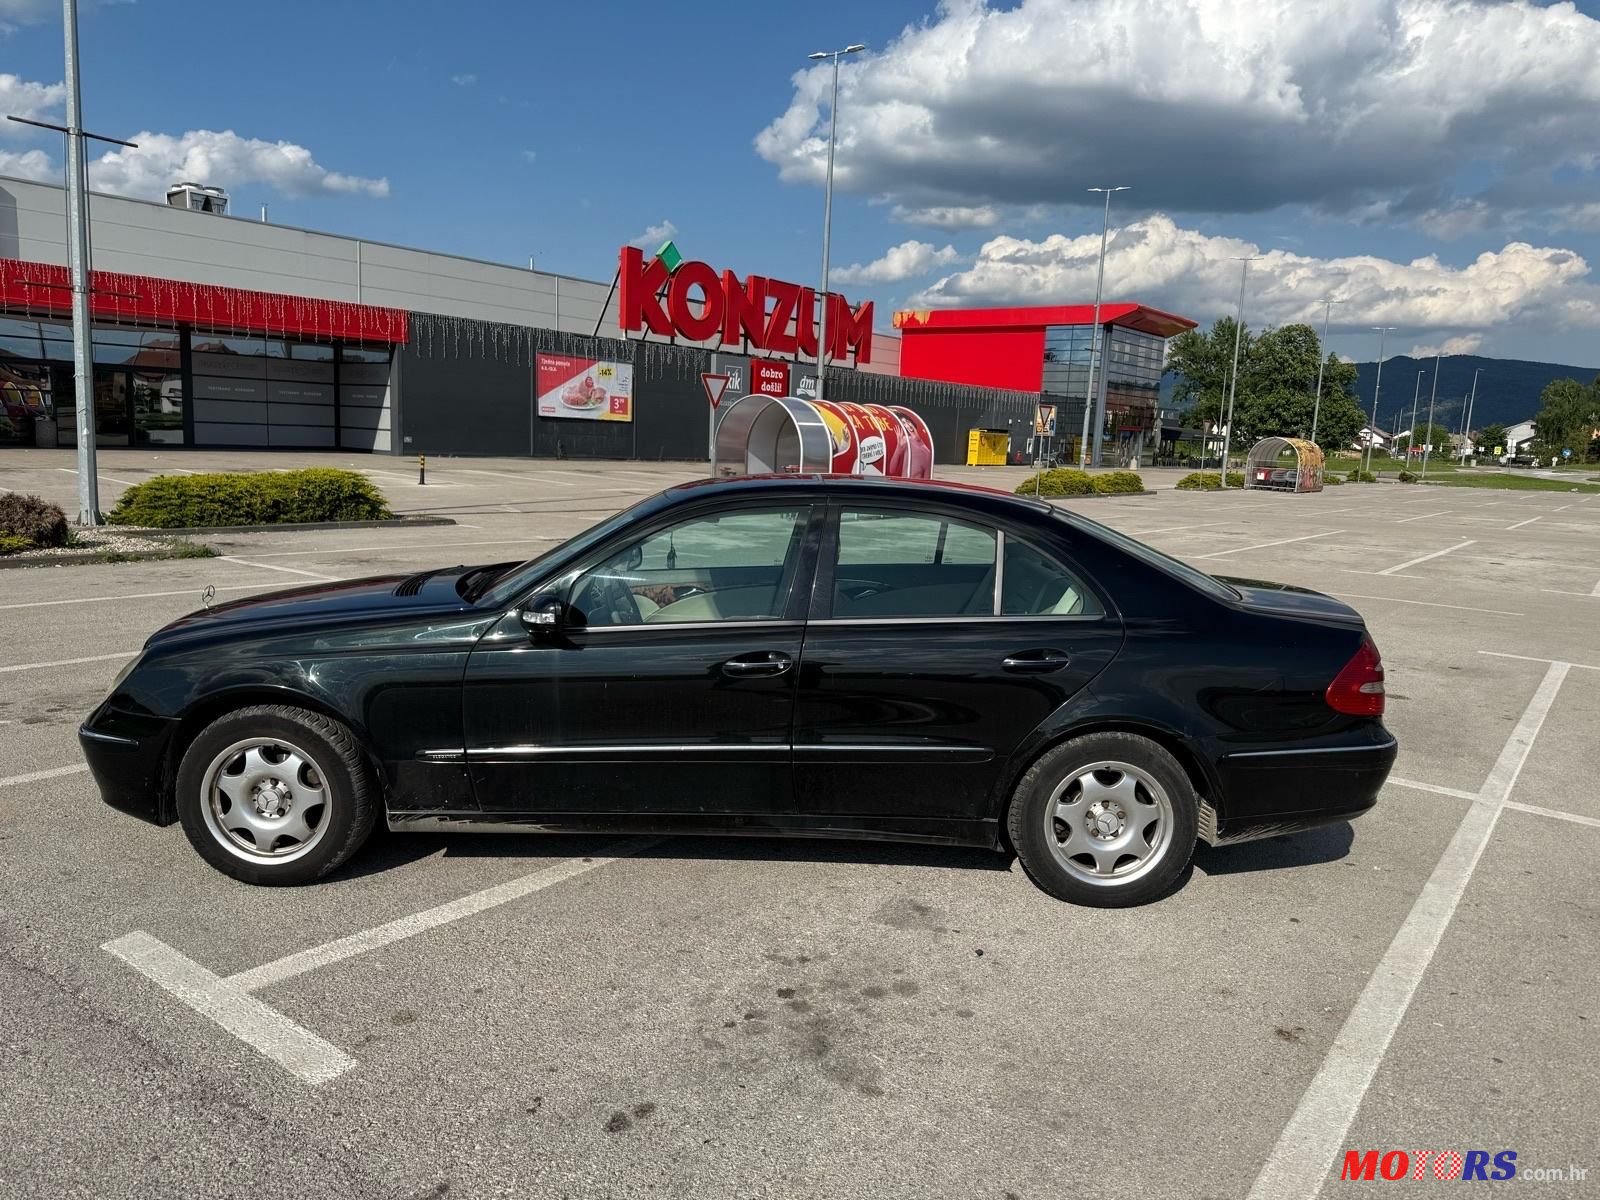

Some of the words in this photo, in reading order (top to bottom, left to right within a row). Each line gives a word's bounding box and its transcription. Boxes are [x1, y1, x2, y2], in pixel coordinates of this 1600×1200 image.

[620, 246, 874, 363] KONZUM
[760, 367, 784, 379] dobro
[726, 370, 741, 391] kik
[761, 381, 782, 393] došli!
[800, 376, 815, 389] dm
